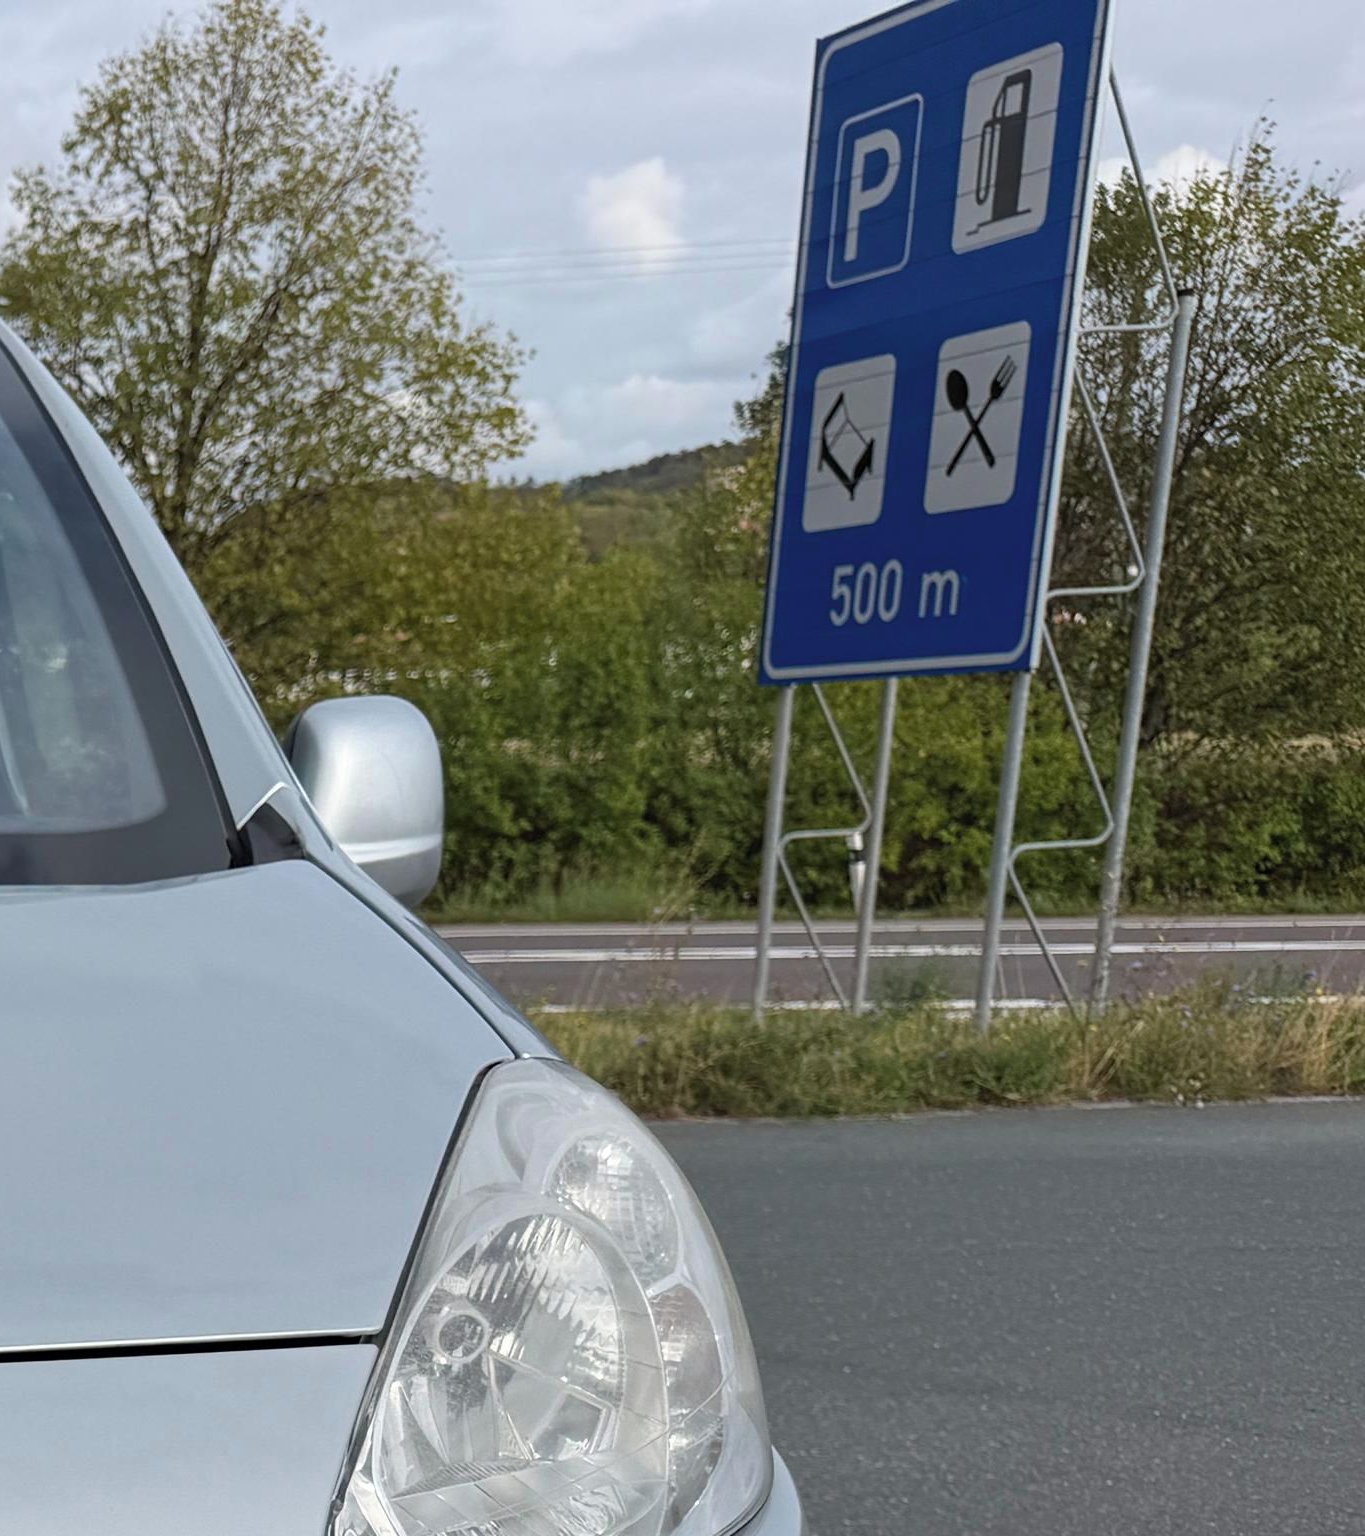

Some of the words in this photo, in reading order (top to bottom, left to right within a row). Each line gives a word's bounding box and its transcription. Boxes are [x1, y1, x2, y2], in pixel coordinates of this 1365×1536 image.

[844, 129, 902, 262] P
[829, 558, 903, 627] 500
[919, 567, 960, 618] m
